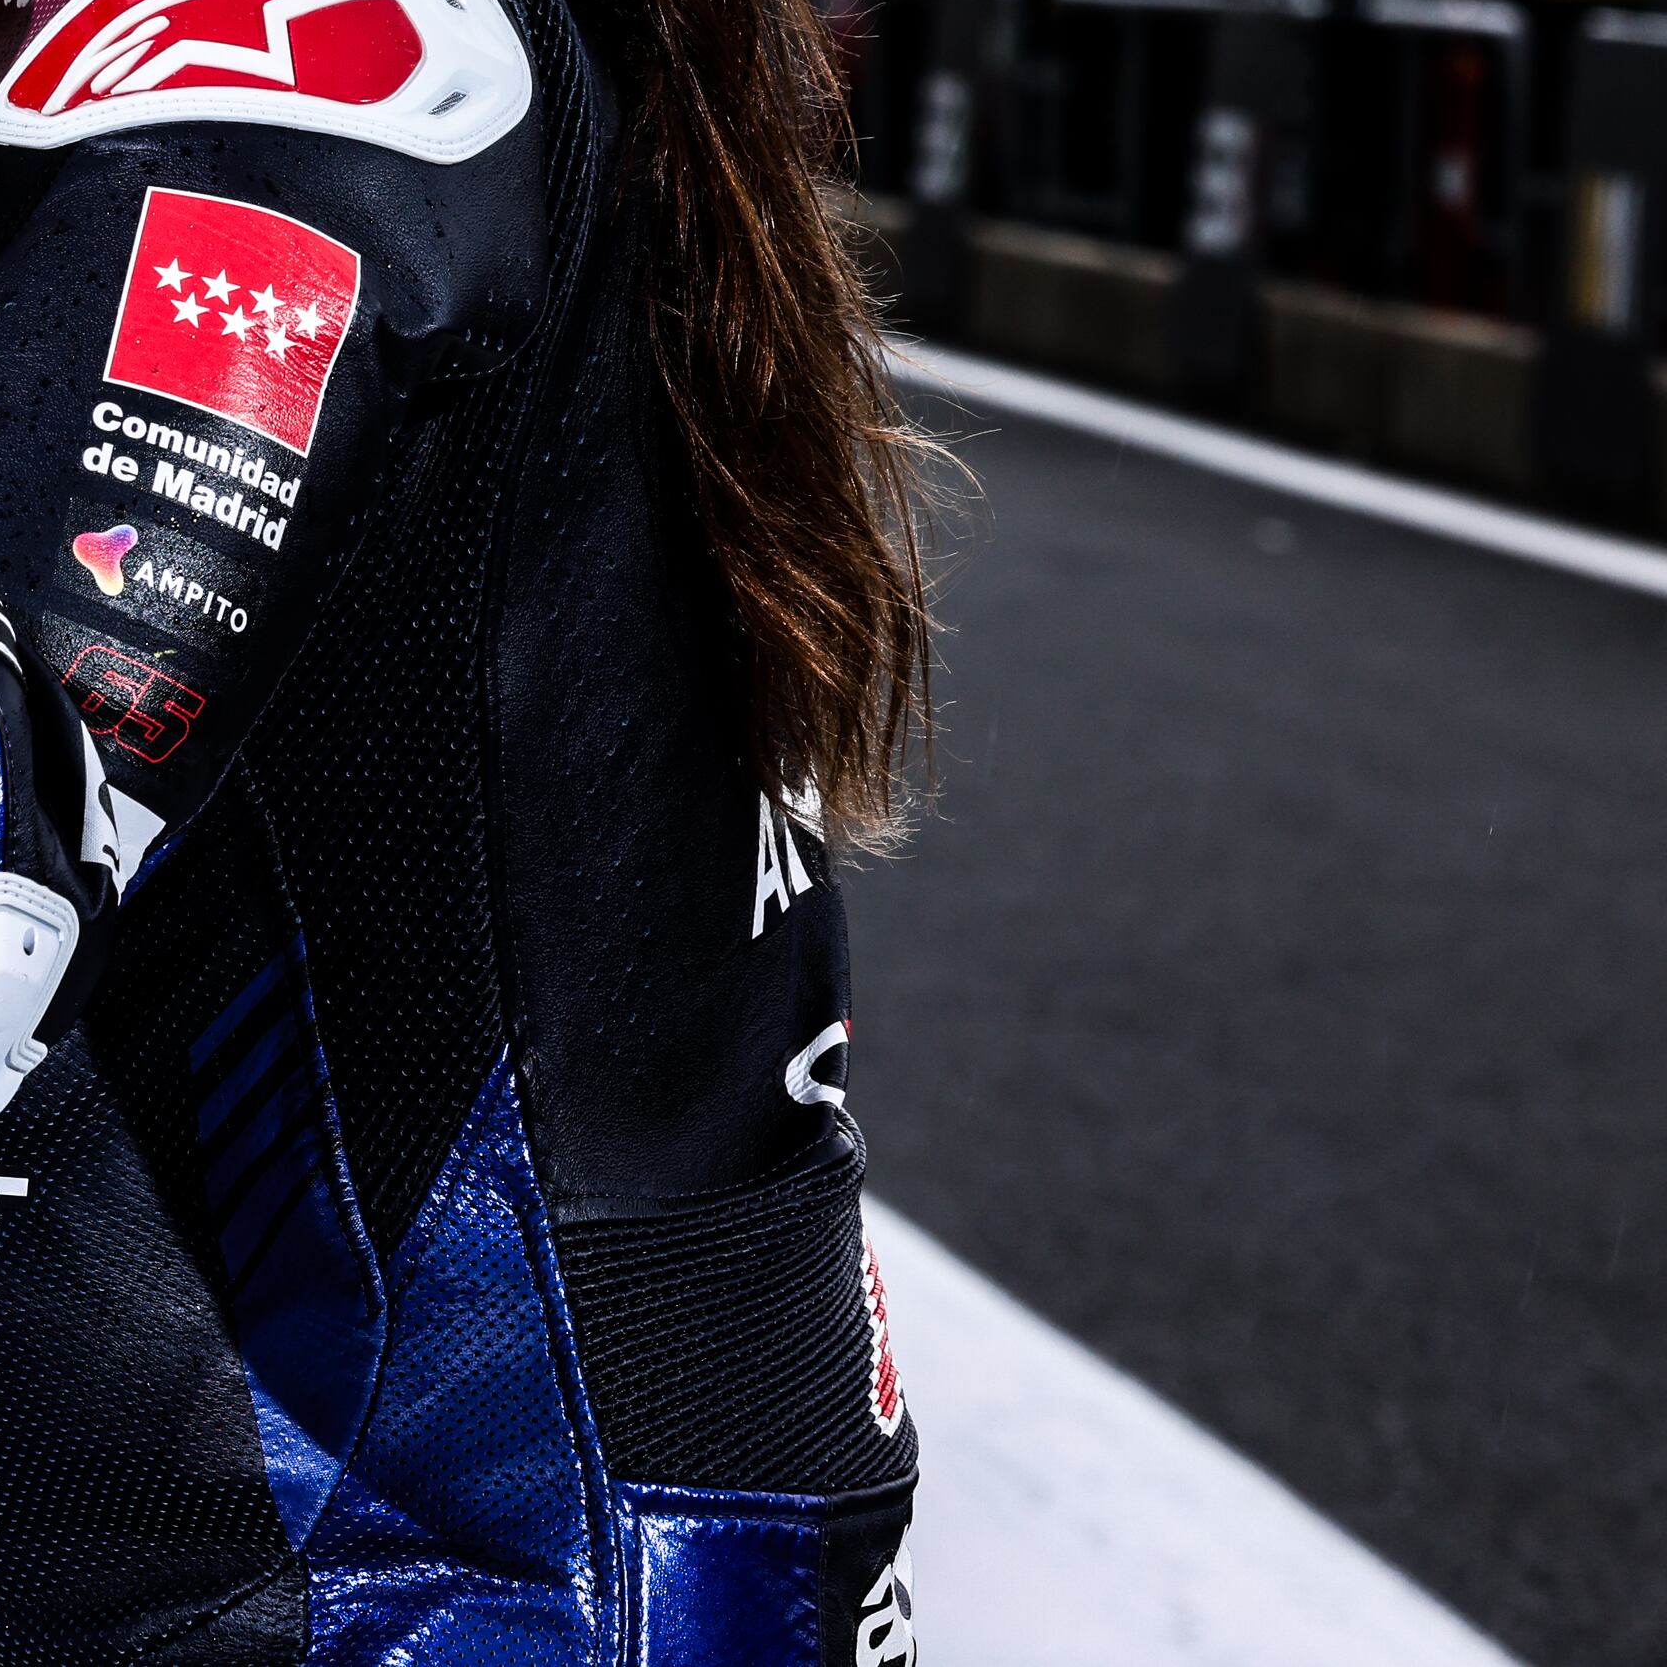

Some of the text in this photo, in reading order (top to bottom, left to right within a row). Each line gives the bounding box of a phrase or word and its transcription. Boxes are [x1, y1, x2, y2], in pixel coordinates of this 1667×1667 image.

[82, 438, 289, 552] de Madrid
[92, 400, 302, 510] Comunidad
[134, 559, 249, 633] AMPITO
